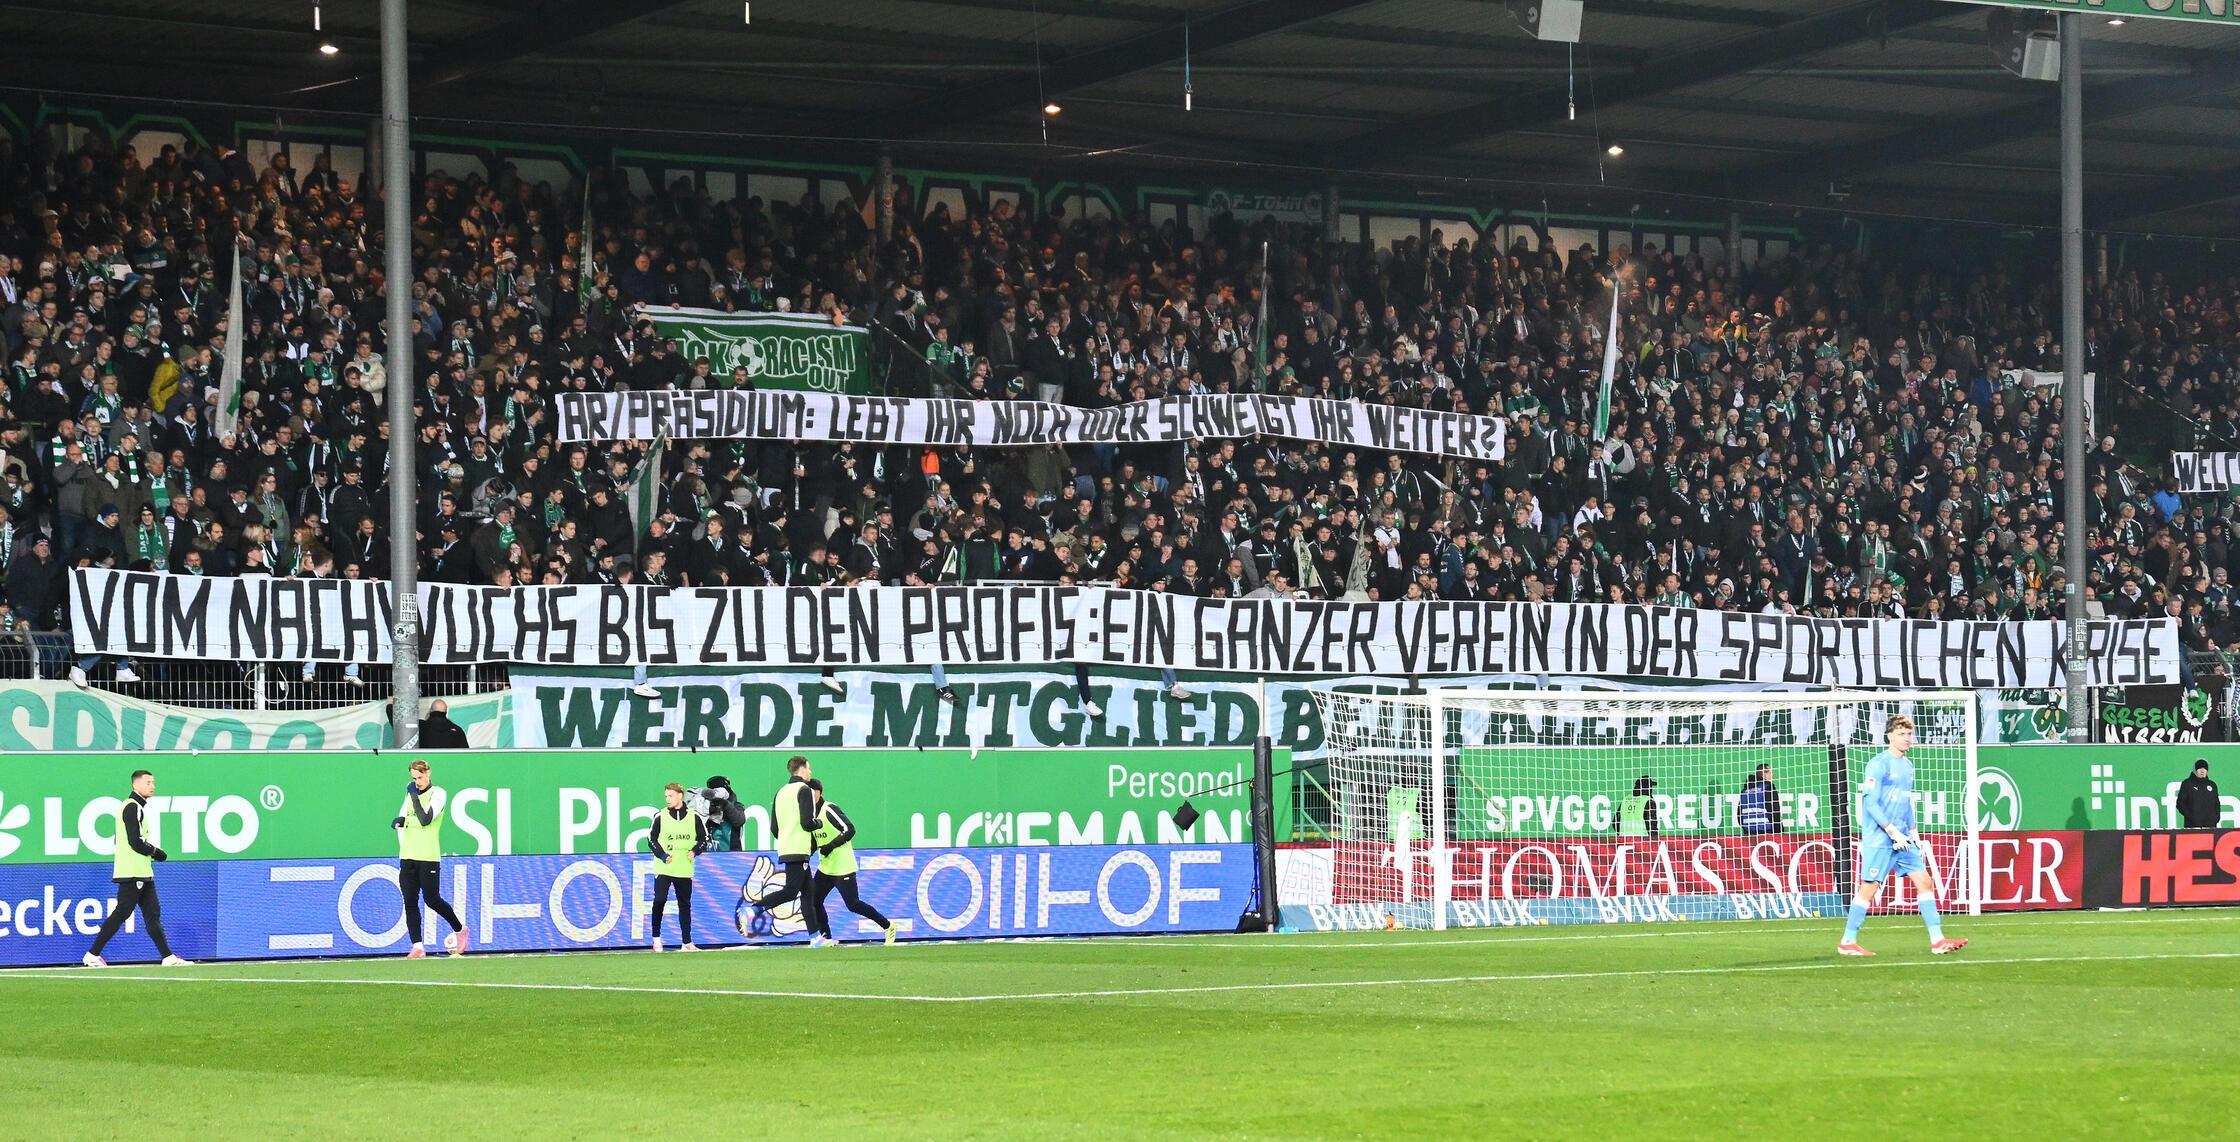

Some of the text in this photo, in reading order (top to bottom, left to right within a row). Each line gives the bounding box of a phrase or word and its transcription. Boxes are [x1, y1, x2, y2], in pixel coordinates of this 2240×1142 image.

[762, 334, 856, 378] RACISM
[807, 364, 850, 394] OUT
[829, 396, 911, 442] LEBT
[924, 399, 976, 444] IHR
[991, 400, 1071, 445] NOCH
[1078, 401, 1149, 442] ODER
[1158, 394, 1300, 439] SCHWEIGT
[1309, 399, 1355, 443] IHR
[1366, 404, 1499, 460] WEITER?
[76, 569, 211, 657] VOM
[229, 579, 577, 663] NACHWUCHS
[599, 585, 677, 664] BIS
[694, 588, 768, 662] ZU
[785, 587, 880, 664] DEN
[1194, 597, 1379, 672] GANZER
[1395, 601, 1551, 672] VEREIN
[1564, 603, 1609, 672] IN
[1624, 605, 1698, 677] DER
[1719, 611, 2027, 687] SPORTLICHEN
[2048, 620, 2167, 688] KRISE
[536, 681, 848, 748] WERDE
[866, 680, 1261, 747] MITGLIED
[2102, 704, 2179, 728] GREEN
[1109, 763, 1242, 799] Personal
[44, 793, 259, 855] LOTTO
[1486, 795, 1612, 831] SPVGG
